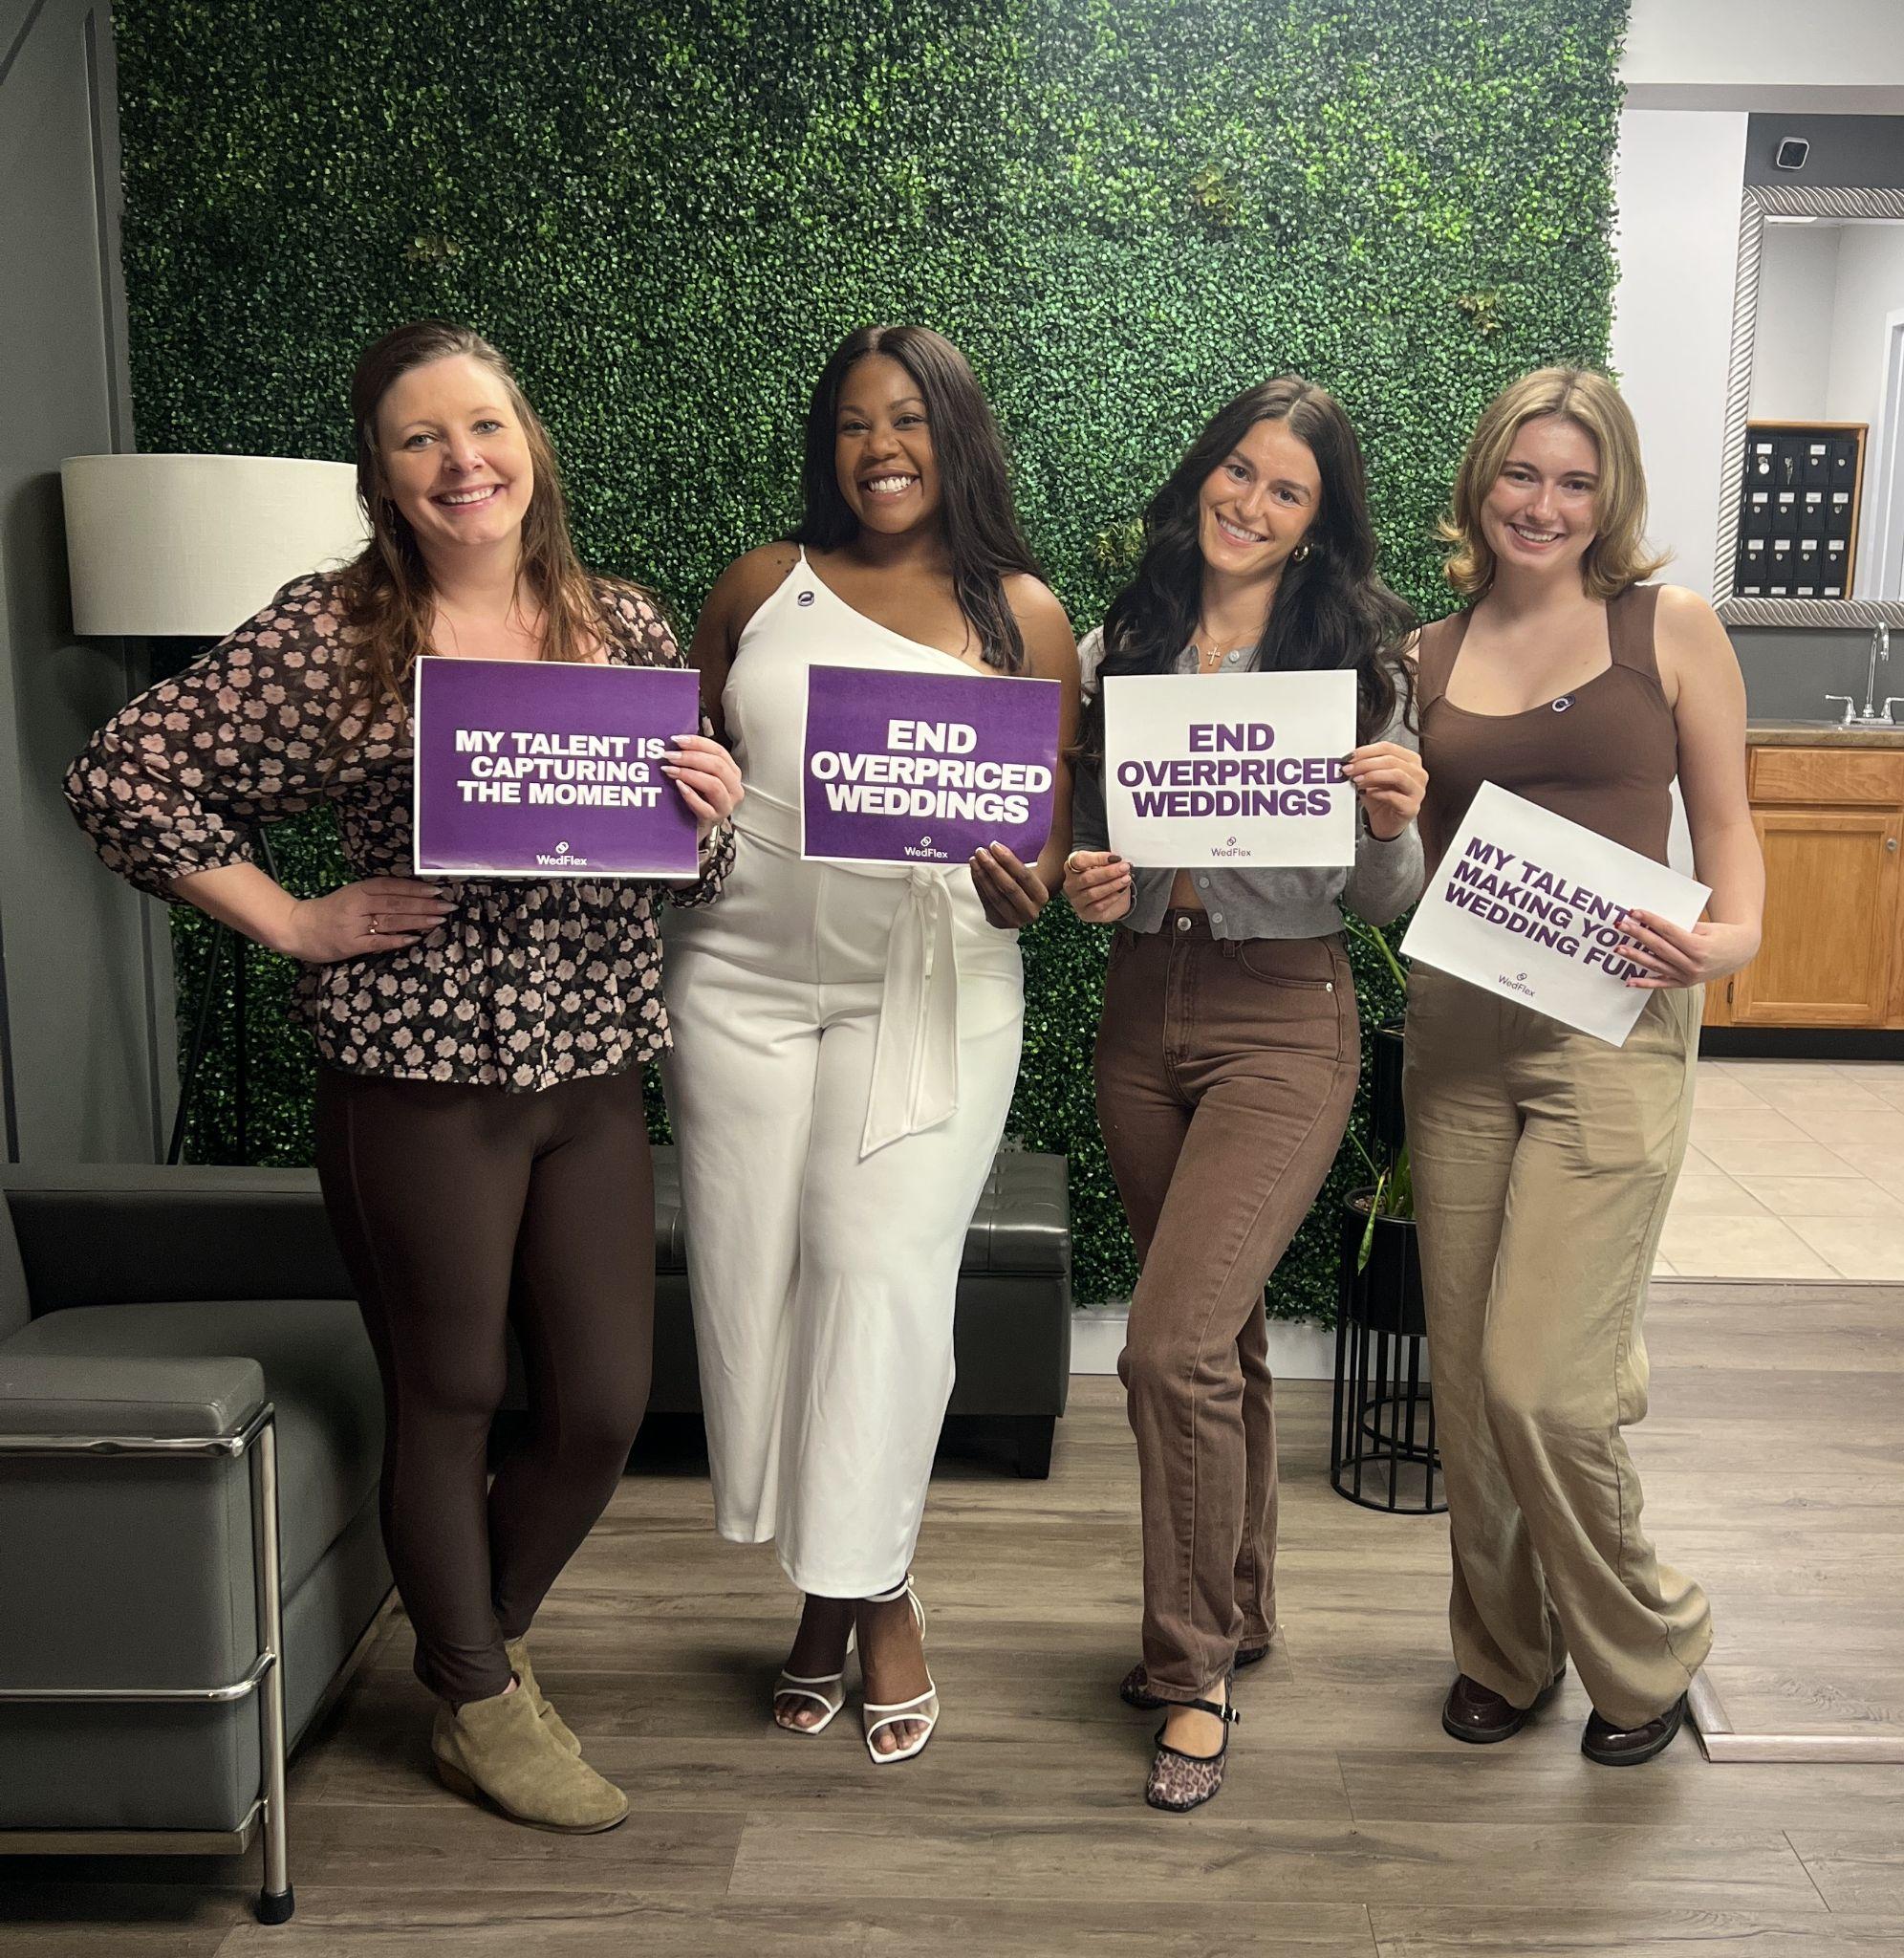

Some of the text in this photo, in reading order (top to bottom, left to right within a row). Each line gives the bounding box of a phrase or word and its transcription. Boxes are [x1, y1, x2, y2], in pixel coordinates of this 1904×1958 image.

[455, 729, 666, 759] MY TALENT IS
[887, 719, 977, 753] END
[1189, 723, 1275, 752] END
[471, 756, 649, 783] CAPTURING
[811, 751, 1052, 793] OVERPRICED
[1116, 757, 1350, 787] OVERPRICED
[457, 780, 662, 808] THE MOMENT
[825, 783, 1029, 824] WEDDINGS
[1132, 789, 1331, 817] WEDDINGS
[536, 855, 587, 866] WedFlex
[904, 846, 948, 859] WedFlex
[1211, 847, 1251, 858] WedFlex
[1453, 859, 1573, 929] MAKING
[1464, 837, 1631, 925] MY TALENT
[1444, 881, 1580, 958] WEDDING
[1498, 973, 1536, 998] WedFlex
